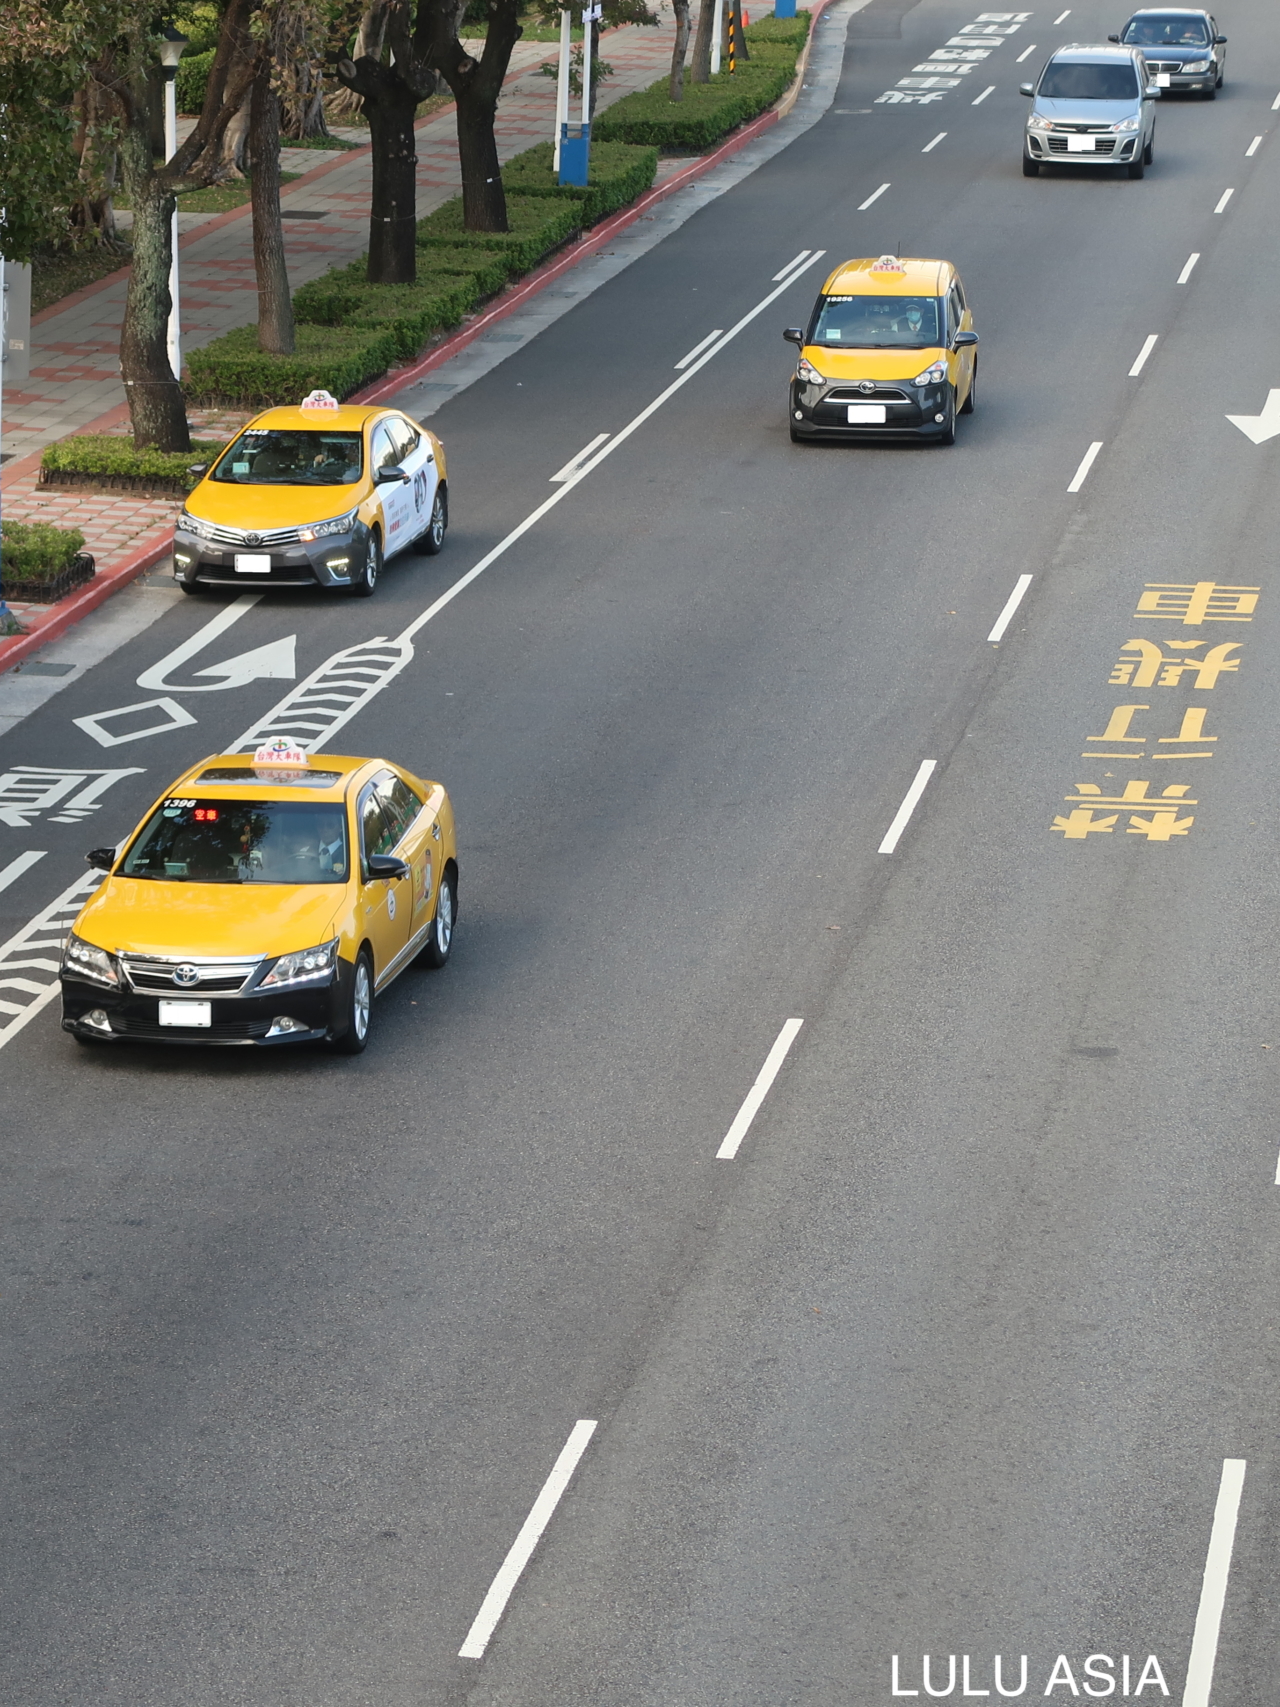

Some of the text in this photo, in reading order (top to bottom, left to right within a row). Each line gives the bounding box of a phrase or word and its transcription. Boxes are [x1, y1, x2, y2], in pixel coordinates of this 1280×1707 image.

[258, 751, 301, 761] 台灣大車隊
[164, 799, 197, 808] 1396
[195, 809, 217, 820] 空車
